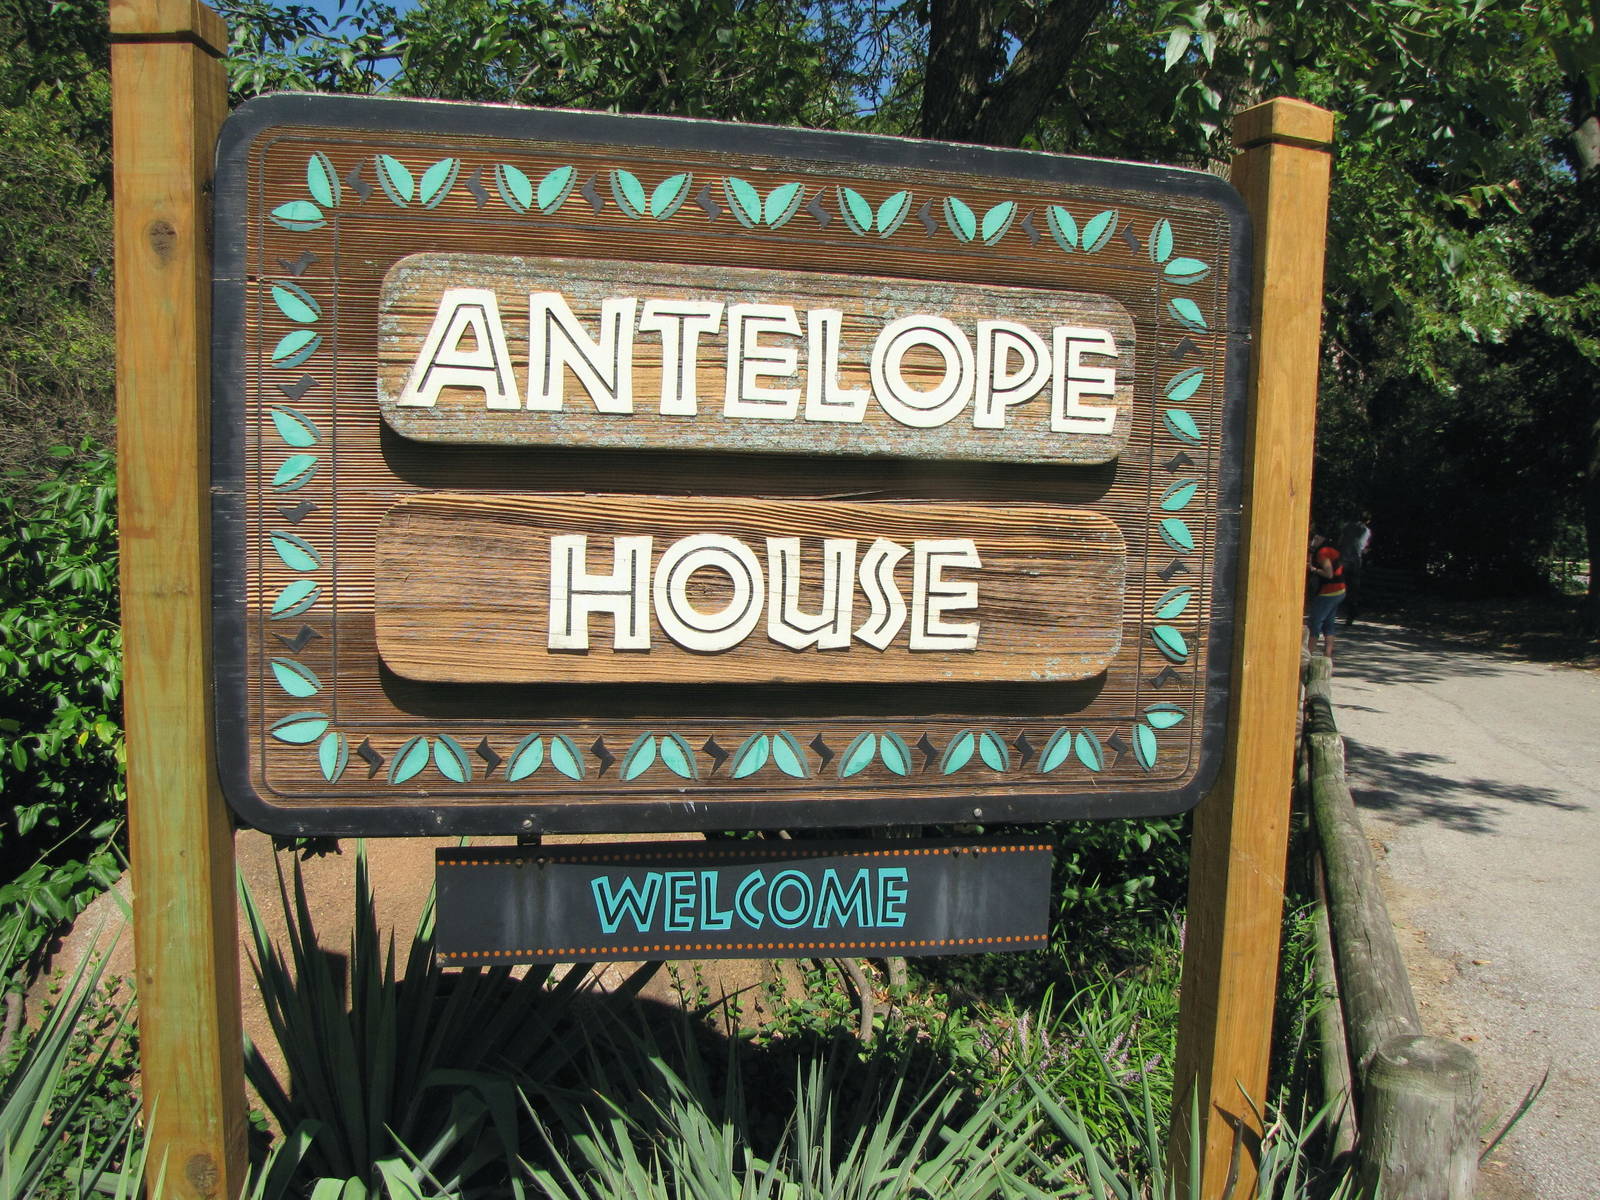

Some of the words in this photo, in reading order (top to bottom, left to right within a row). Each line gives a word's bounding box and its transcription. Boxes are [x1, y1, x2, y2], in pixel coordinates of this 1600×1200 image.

[397, 287, 1120, 436] ANTELOPE
[547, 533, 983, 652] HOUSE
[590, 866, 909, 934] WELCOME
